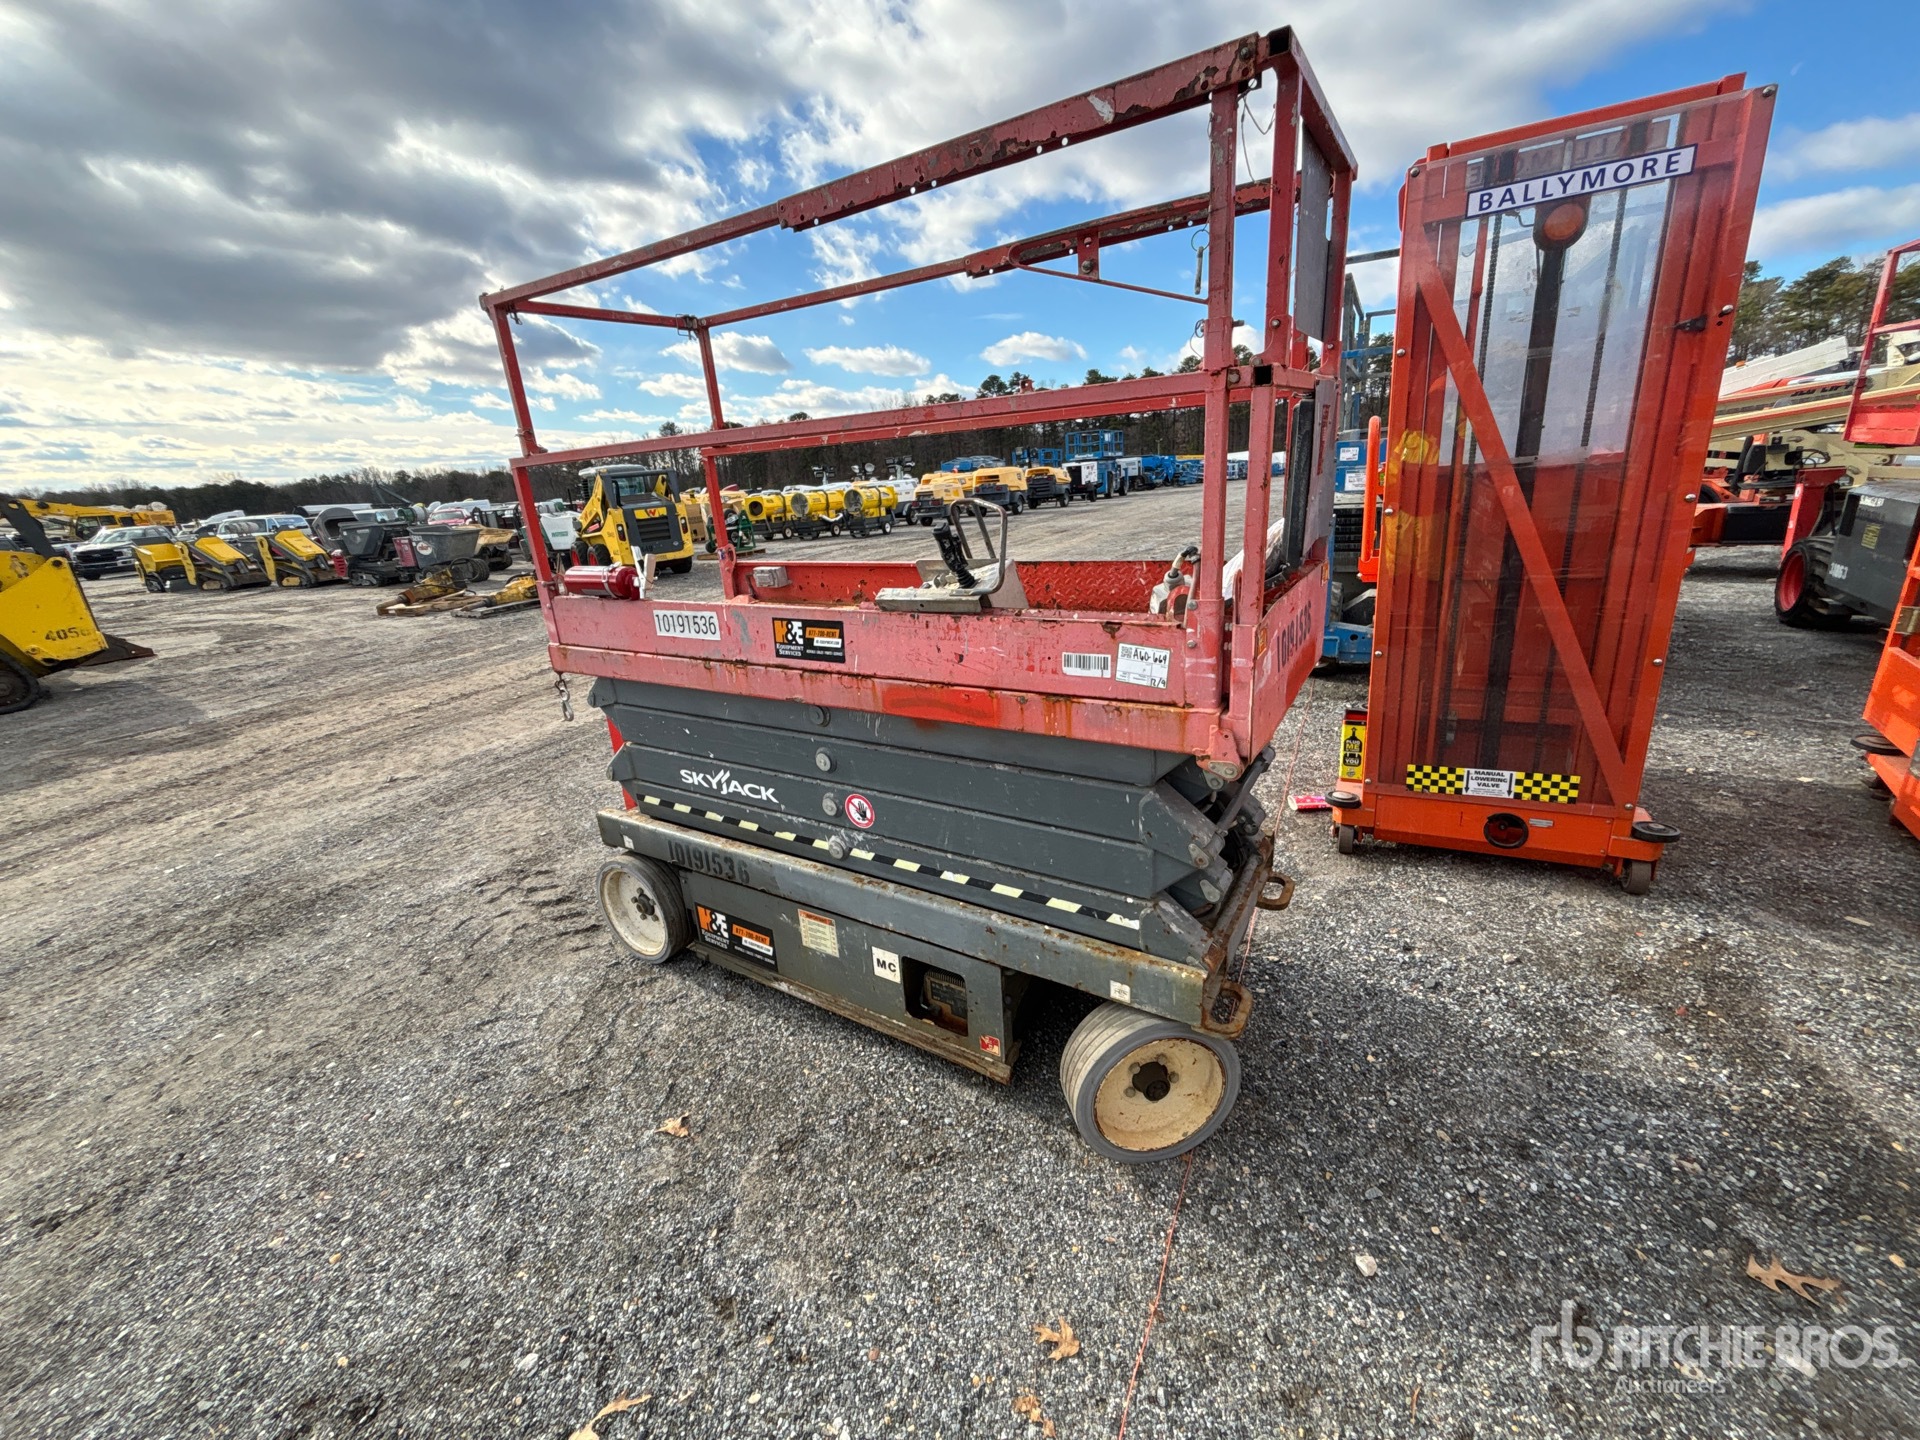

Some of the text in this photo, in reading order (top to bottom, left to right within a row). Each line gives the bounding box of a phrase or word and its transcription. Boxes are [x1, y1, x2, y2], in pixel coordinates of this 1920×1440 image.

[1478, 151, 1682, 212] BALLYMORE
[655, 614, 717, 635] 10191536
[774, 620, 804, 645] H&E
[776, 643, 804, 651] EQUIPMENT
[779, 649, 802, 657] SERVICES
[1470, 776, 1508, 784] LOWERING
[1473, 770, 1505, 778] MANUAL
[679, 769, 779, 803] SKYJACK
[668, 840, 750, 884] 10191536
[697, 906, 729, 939] H&E
[704, 935, 728, 949] SERVICES
[876, 957, 897, 973] MC
